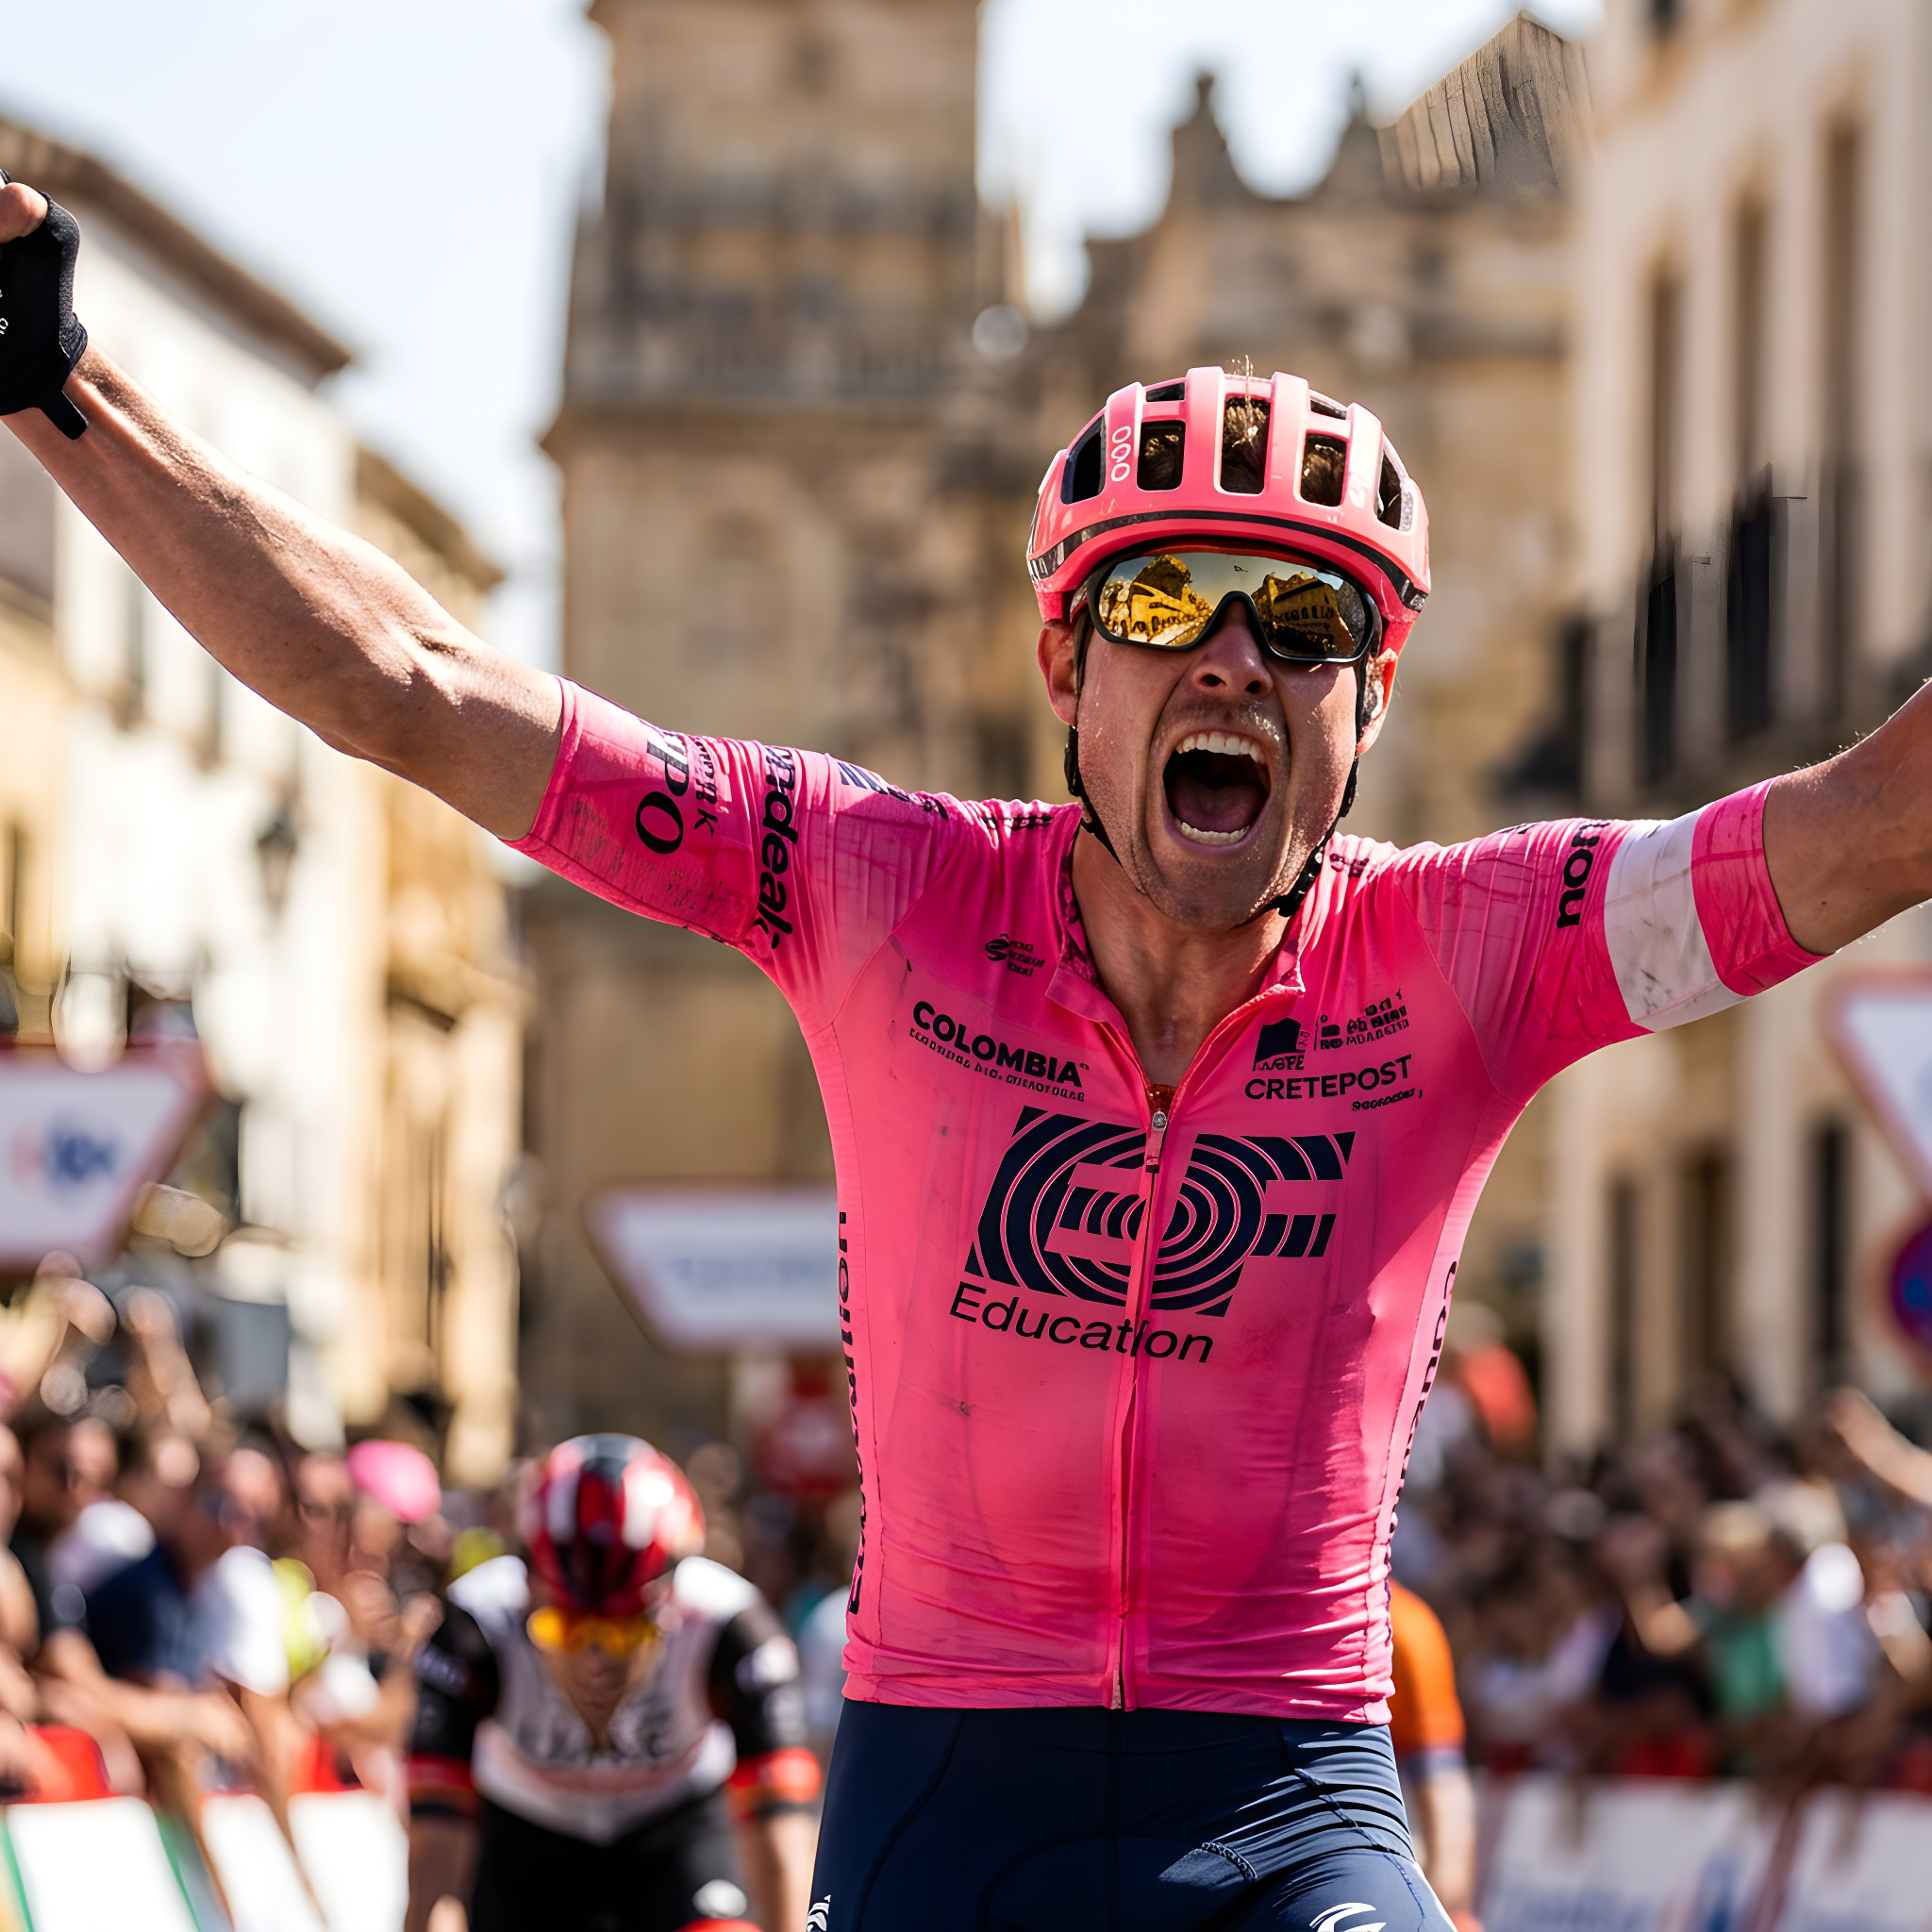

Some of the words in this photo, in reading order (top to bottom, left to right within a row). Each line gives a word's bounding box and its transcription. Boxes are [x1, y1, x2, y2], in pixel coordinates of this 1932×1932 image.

[912, 1001, 1082, 1088] COLOMBIA
[1244, 1054, 1412, 1100] CRETEPOST
[949, 1281, 1214, 1363] Education
